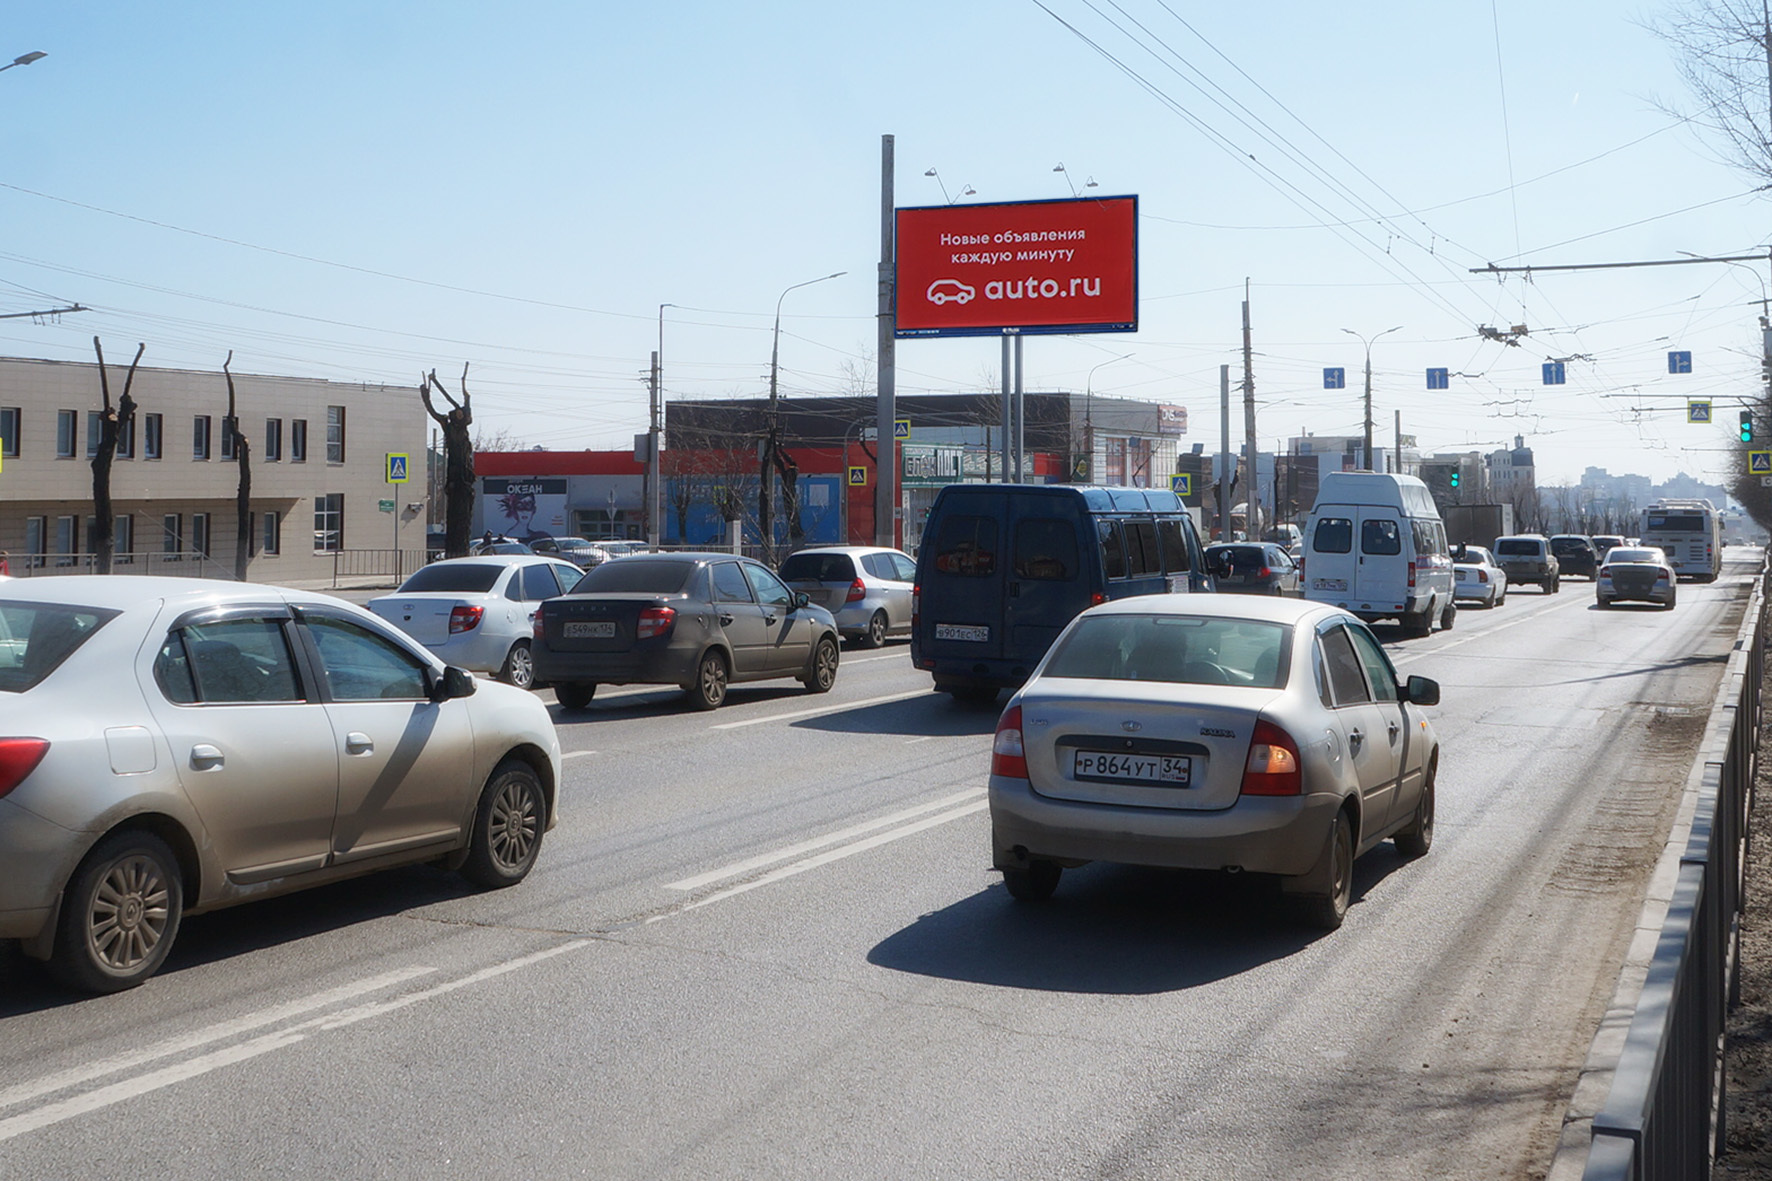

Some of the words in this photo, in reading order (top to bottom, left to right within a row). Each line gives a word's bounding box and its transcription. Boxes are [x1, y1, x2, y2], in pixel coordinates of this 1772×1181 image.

[940, 232, 989, 246] Новые
[994, 229, 1086, 244] объявления
[951, 251, 1012, 265] каждую
[1016, 248, 1075, 263] минуту
[984, 276, 1101, 300] auto.ru
